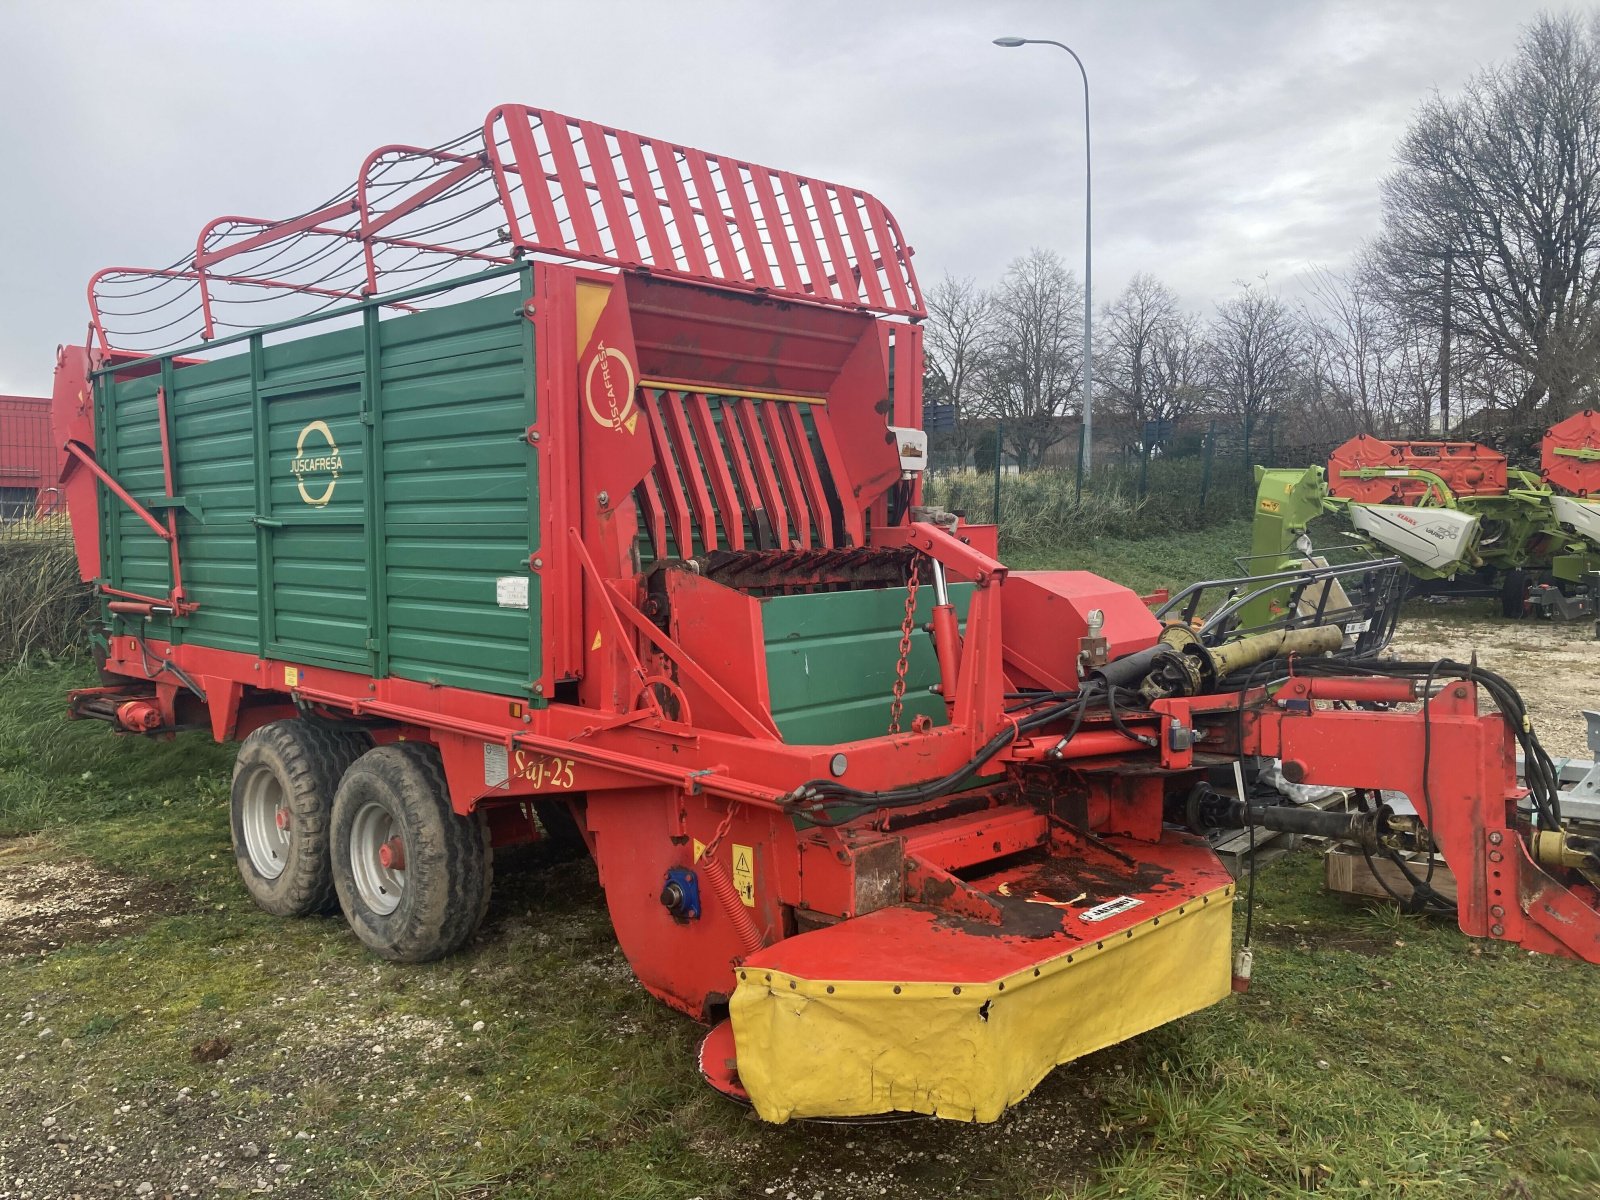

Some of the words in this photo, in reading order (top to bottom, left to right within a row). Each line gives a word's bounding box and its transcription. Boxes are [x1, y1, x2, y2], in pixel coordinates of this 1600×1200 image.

[598, 340, 623, 433] JUSCAFRESA
[290, 457, 343, 472] JUSCAFRESA
[1397, 513, 1418, 526] CLAAS
[1425, 527, 1444, 540] VARIO
[514, 750, 575, 789] Saj-25
